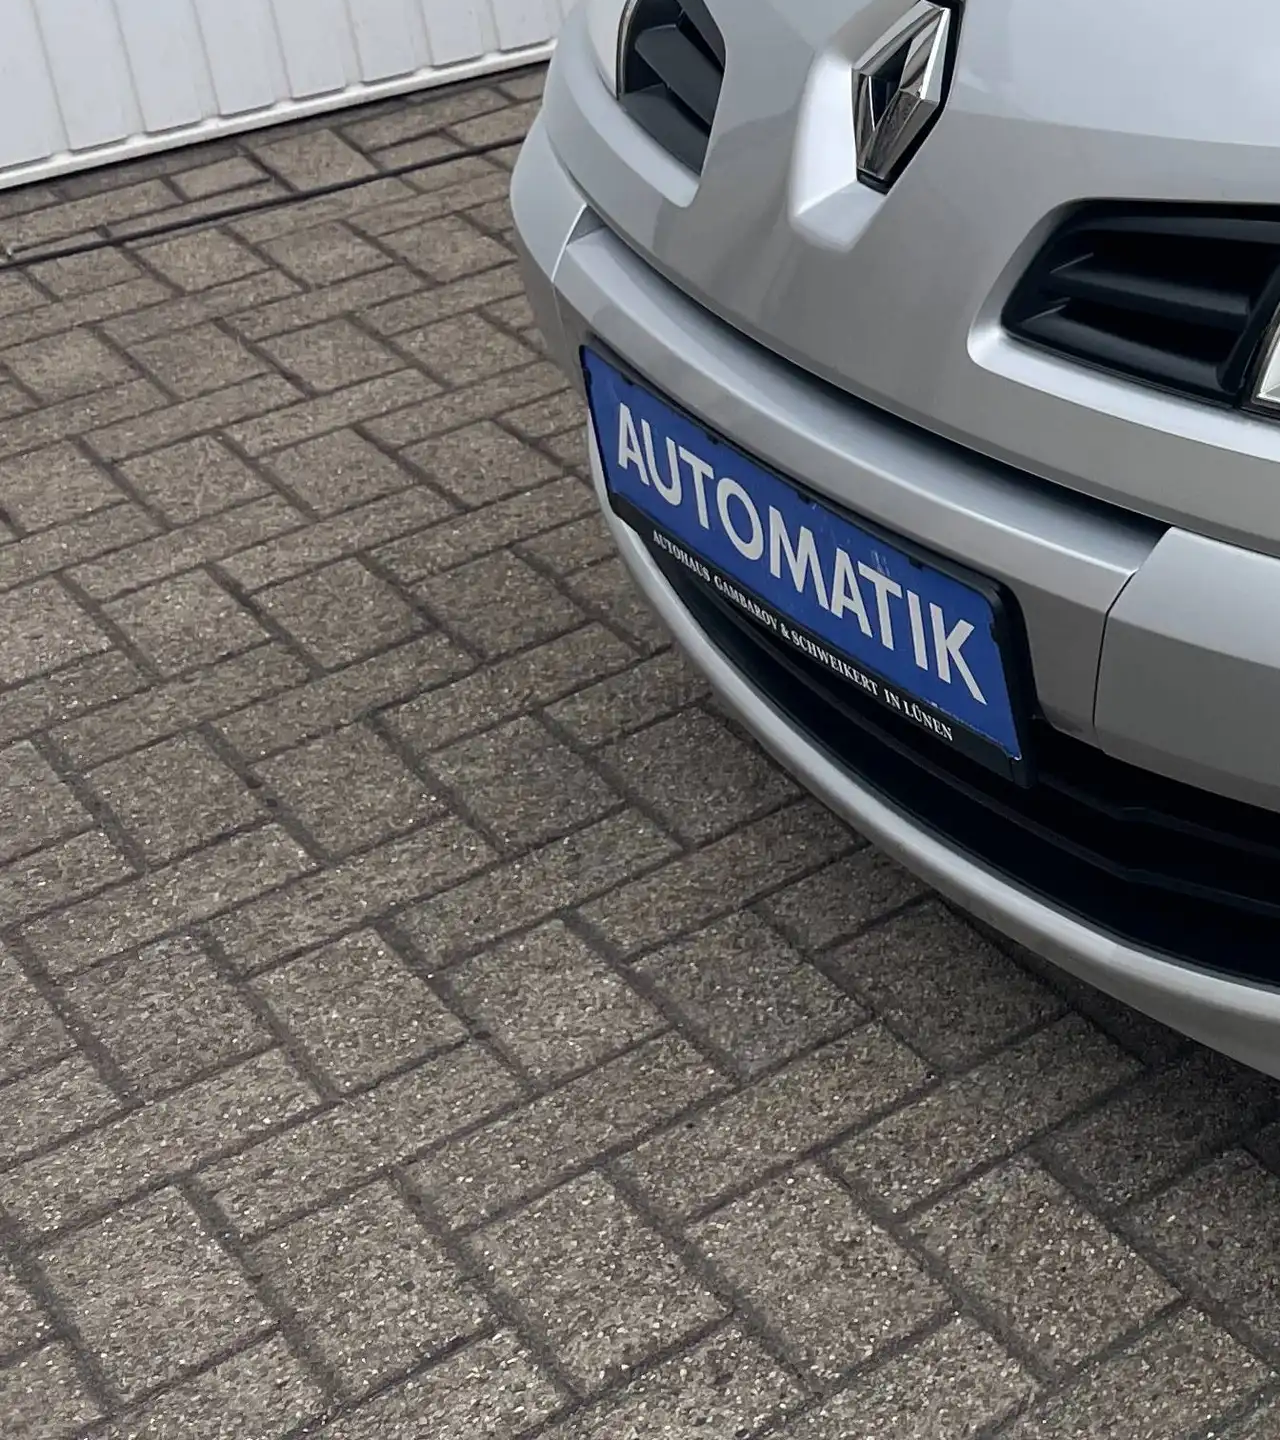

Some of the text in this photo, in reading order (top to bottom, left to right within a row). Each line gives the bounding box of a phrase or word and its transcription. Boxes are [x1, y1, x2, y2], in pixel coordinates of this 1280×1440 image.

[617, 402, 988, 706] AUTOMATIK
[652, 529, 953, 741] AUTOHAUS GAMBAROV & SCHWEIKERT IN LÜNEN
